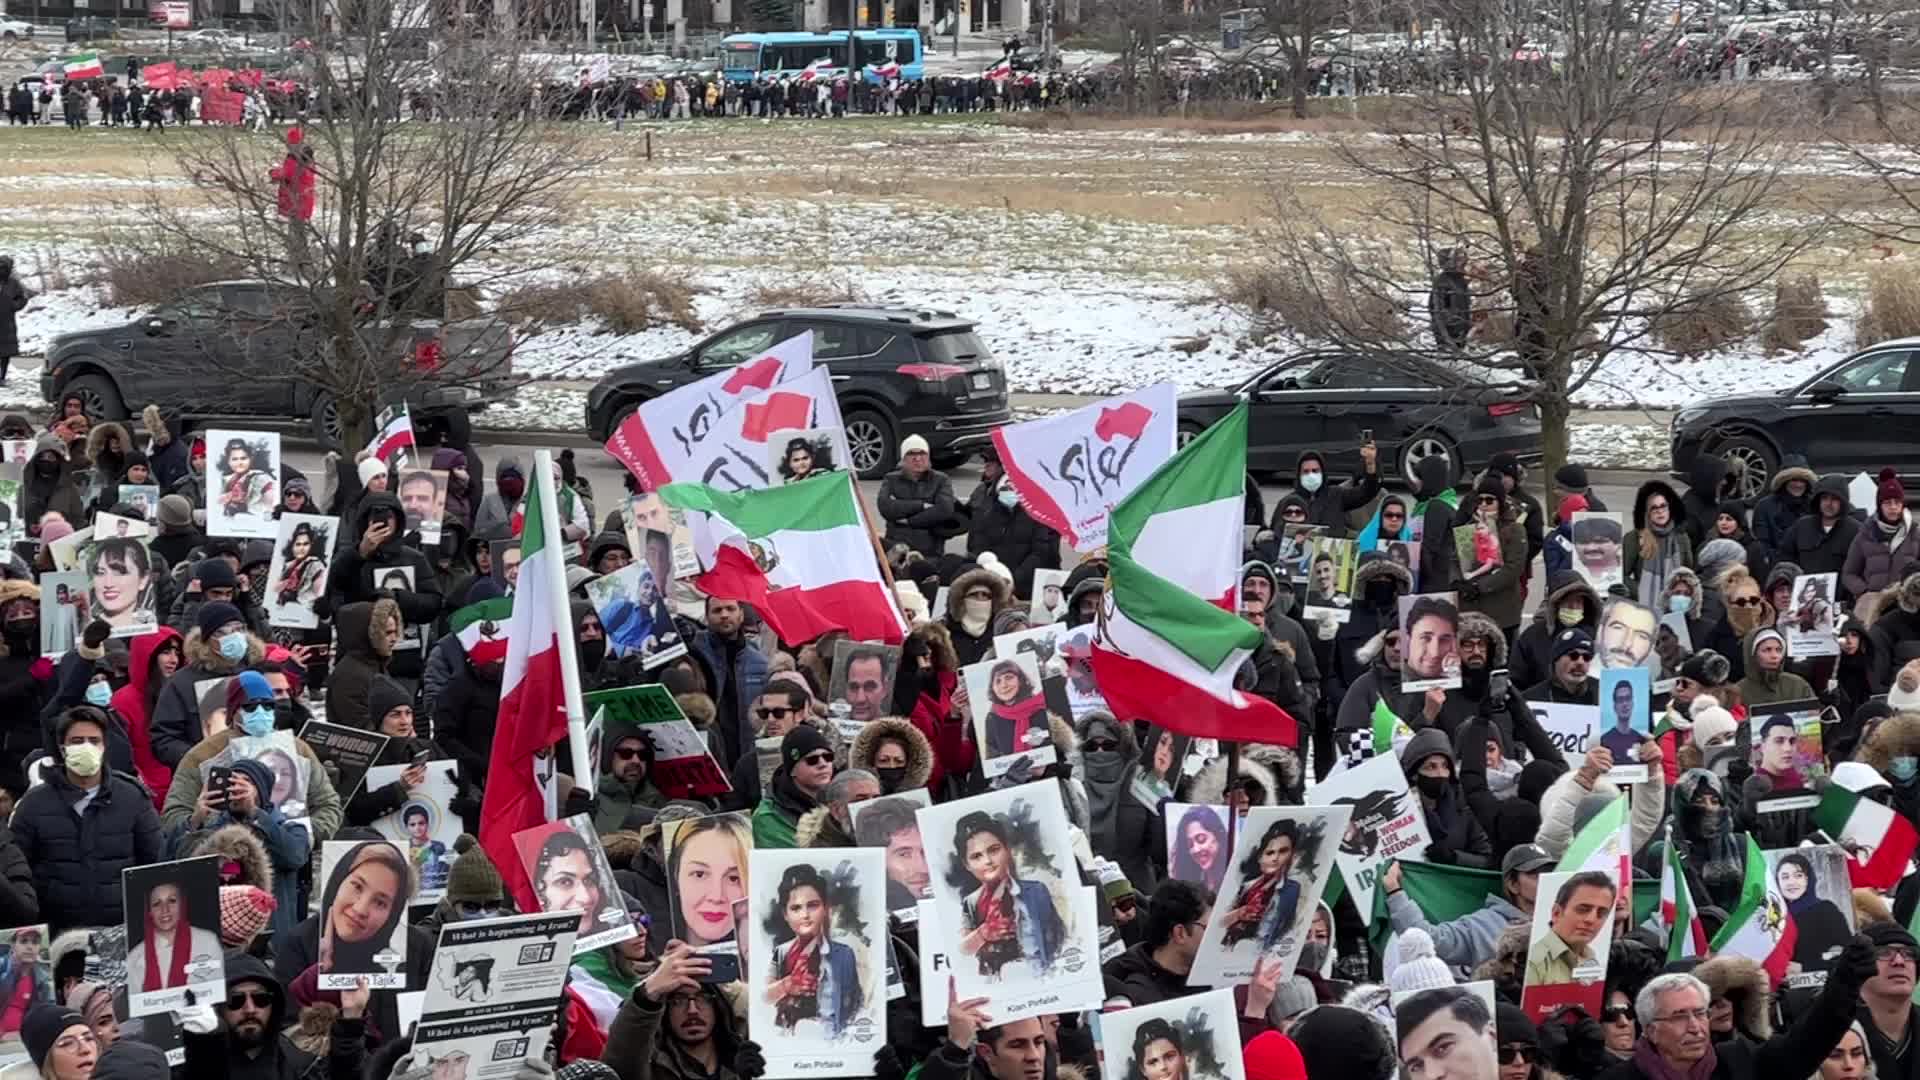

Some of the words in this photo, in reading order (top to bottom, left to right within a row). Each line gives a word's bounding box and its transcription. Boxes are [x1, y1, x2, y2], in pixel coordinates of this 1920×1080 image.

[1379, 814, 1415, 835] WOMAN
[1380, 833, 1422, 857] FREEDOM
[1381, 832, 1399, 847] LIFE
[1355, 868, 1376, 891] IR
[452, 932, 475, 941] What
[488, 926, 535, 938] happening
[548, 920, 574, 929] Iran?
[327, 975, 370, 987] Setarh
[371, 974, 397, 988] Tajik
[1007, 1003, 1027, 1013] Kian
[1028, 995, 1059, 1008] Pirfalak
[426, 1028, 451, 1038] What
[462, 1021, 509, 1034] happening
[522, 1015, 548, 1025] Iran?
[793, 1061, 812, 1069] Kian
[813, 1060, 844, 1069] Pirfalak
